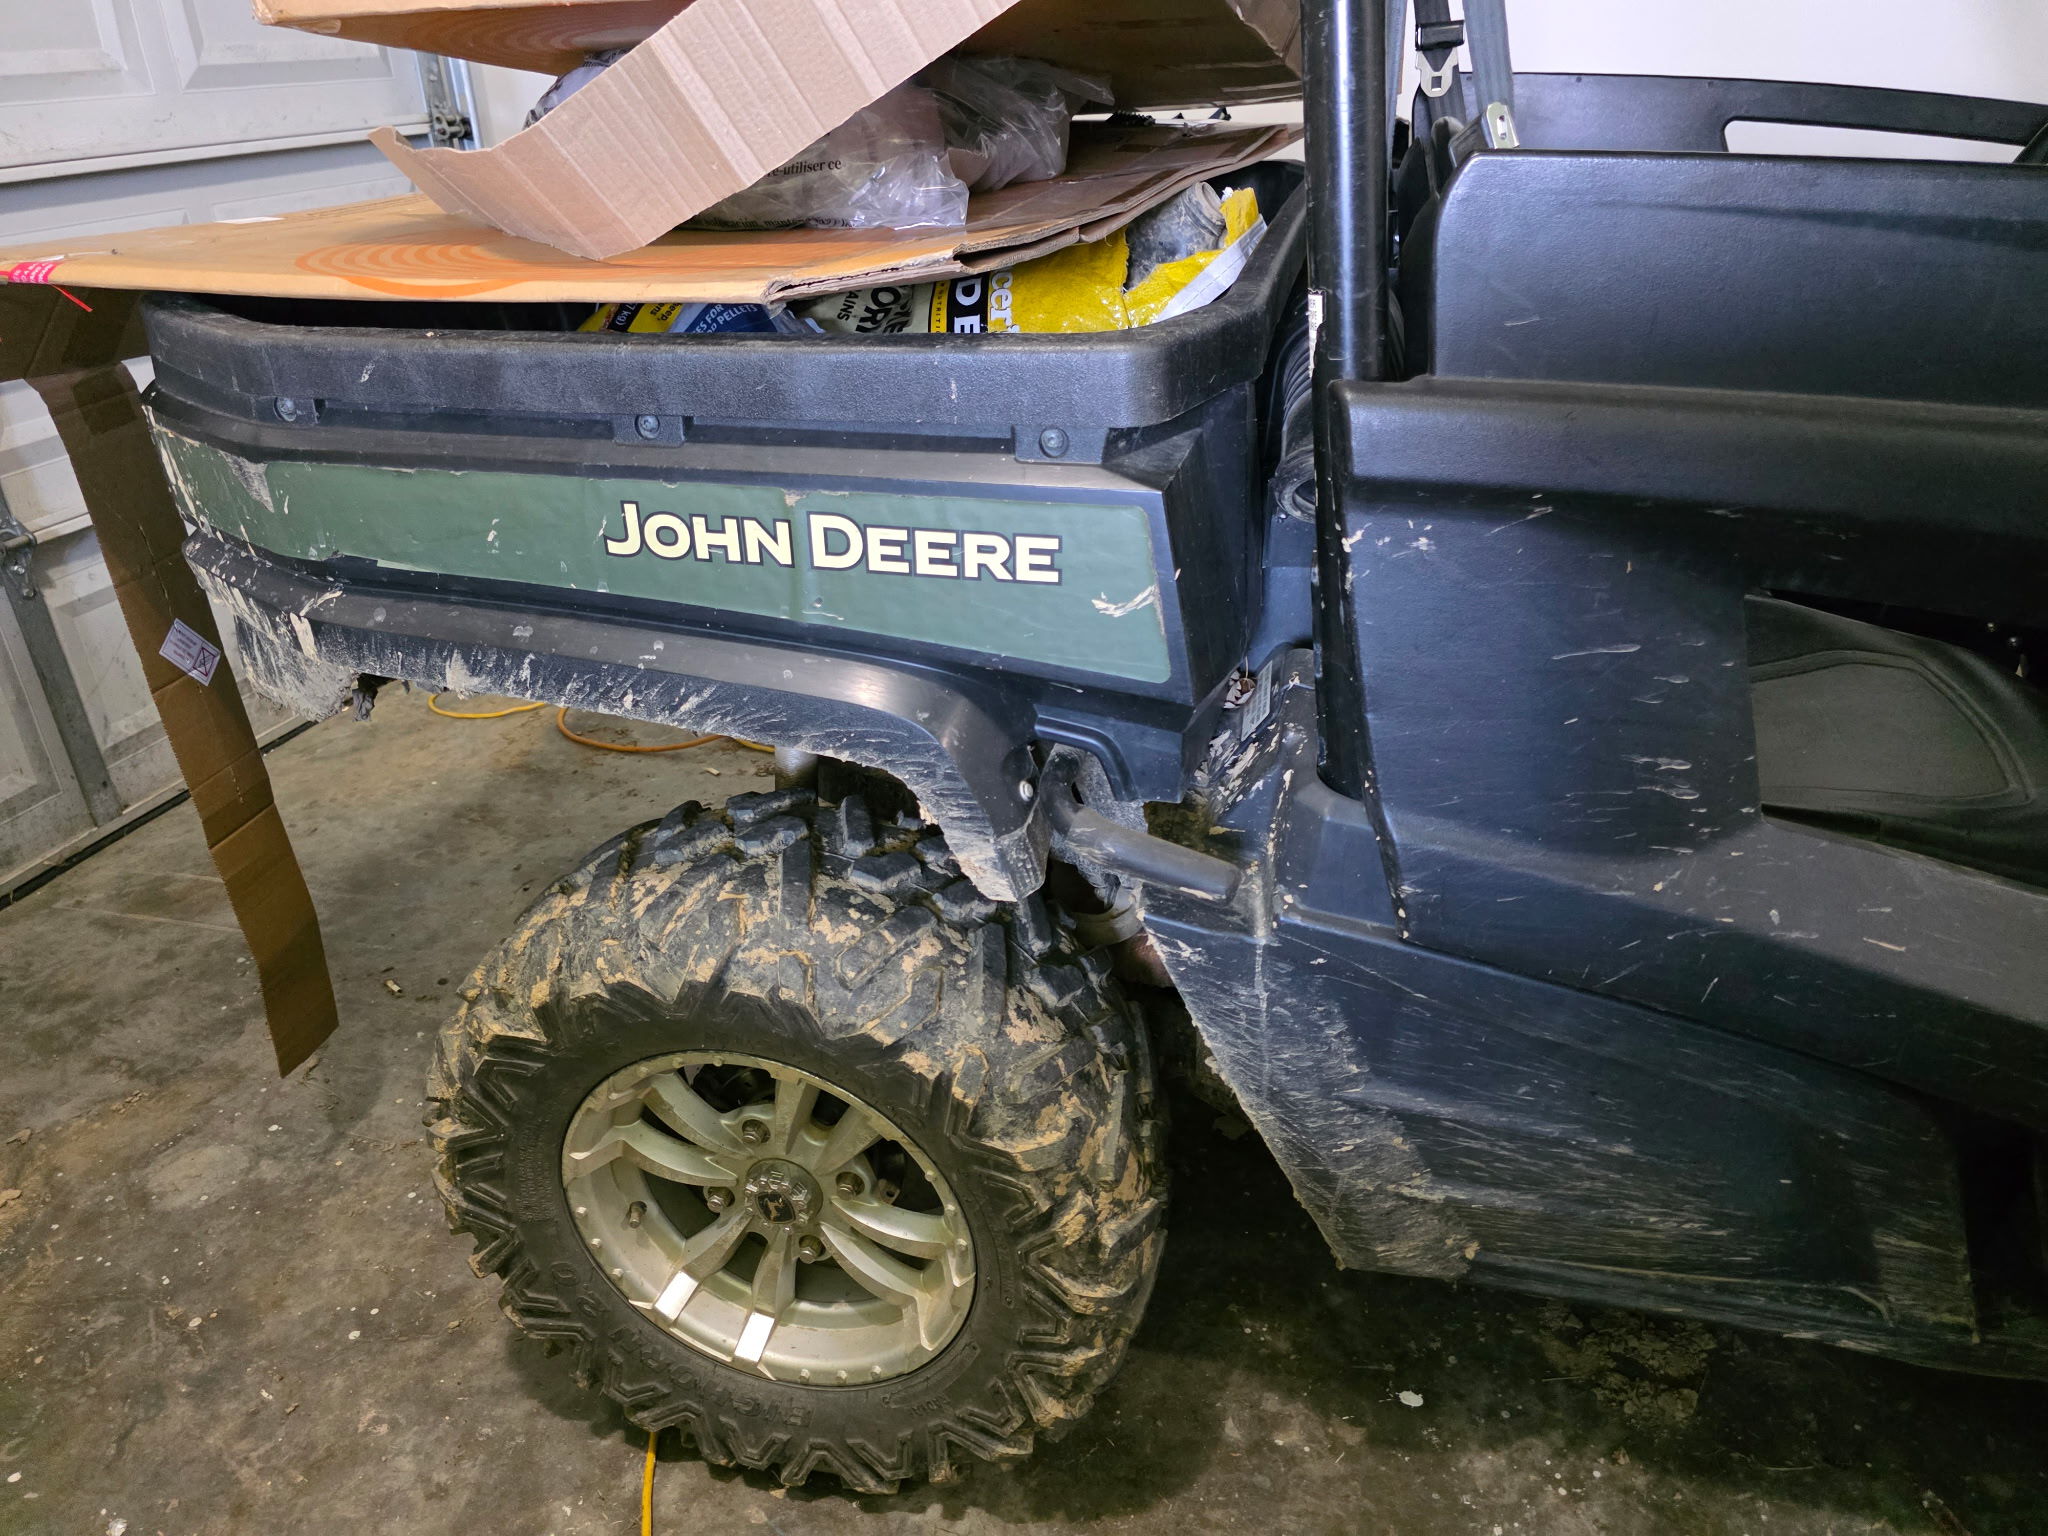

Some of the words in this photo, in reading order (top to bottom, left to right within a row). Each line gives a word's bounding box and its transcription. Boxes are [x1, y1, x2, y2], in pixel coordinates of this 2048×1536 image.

[828, 159, 842, 170] ce
[705, 304, 725, 324] FOR
[716, 304, 758, 325] PELLETS
[837, 290, 860, 321] AINS
[604, 500, 795, 567] JOHN
[806, 511, 1062, 585] DEERE
